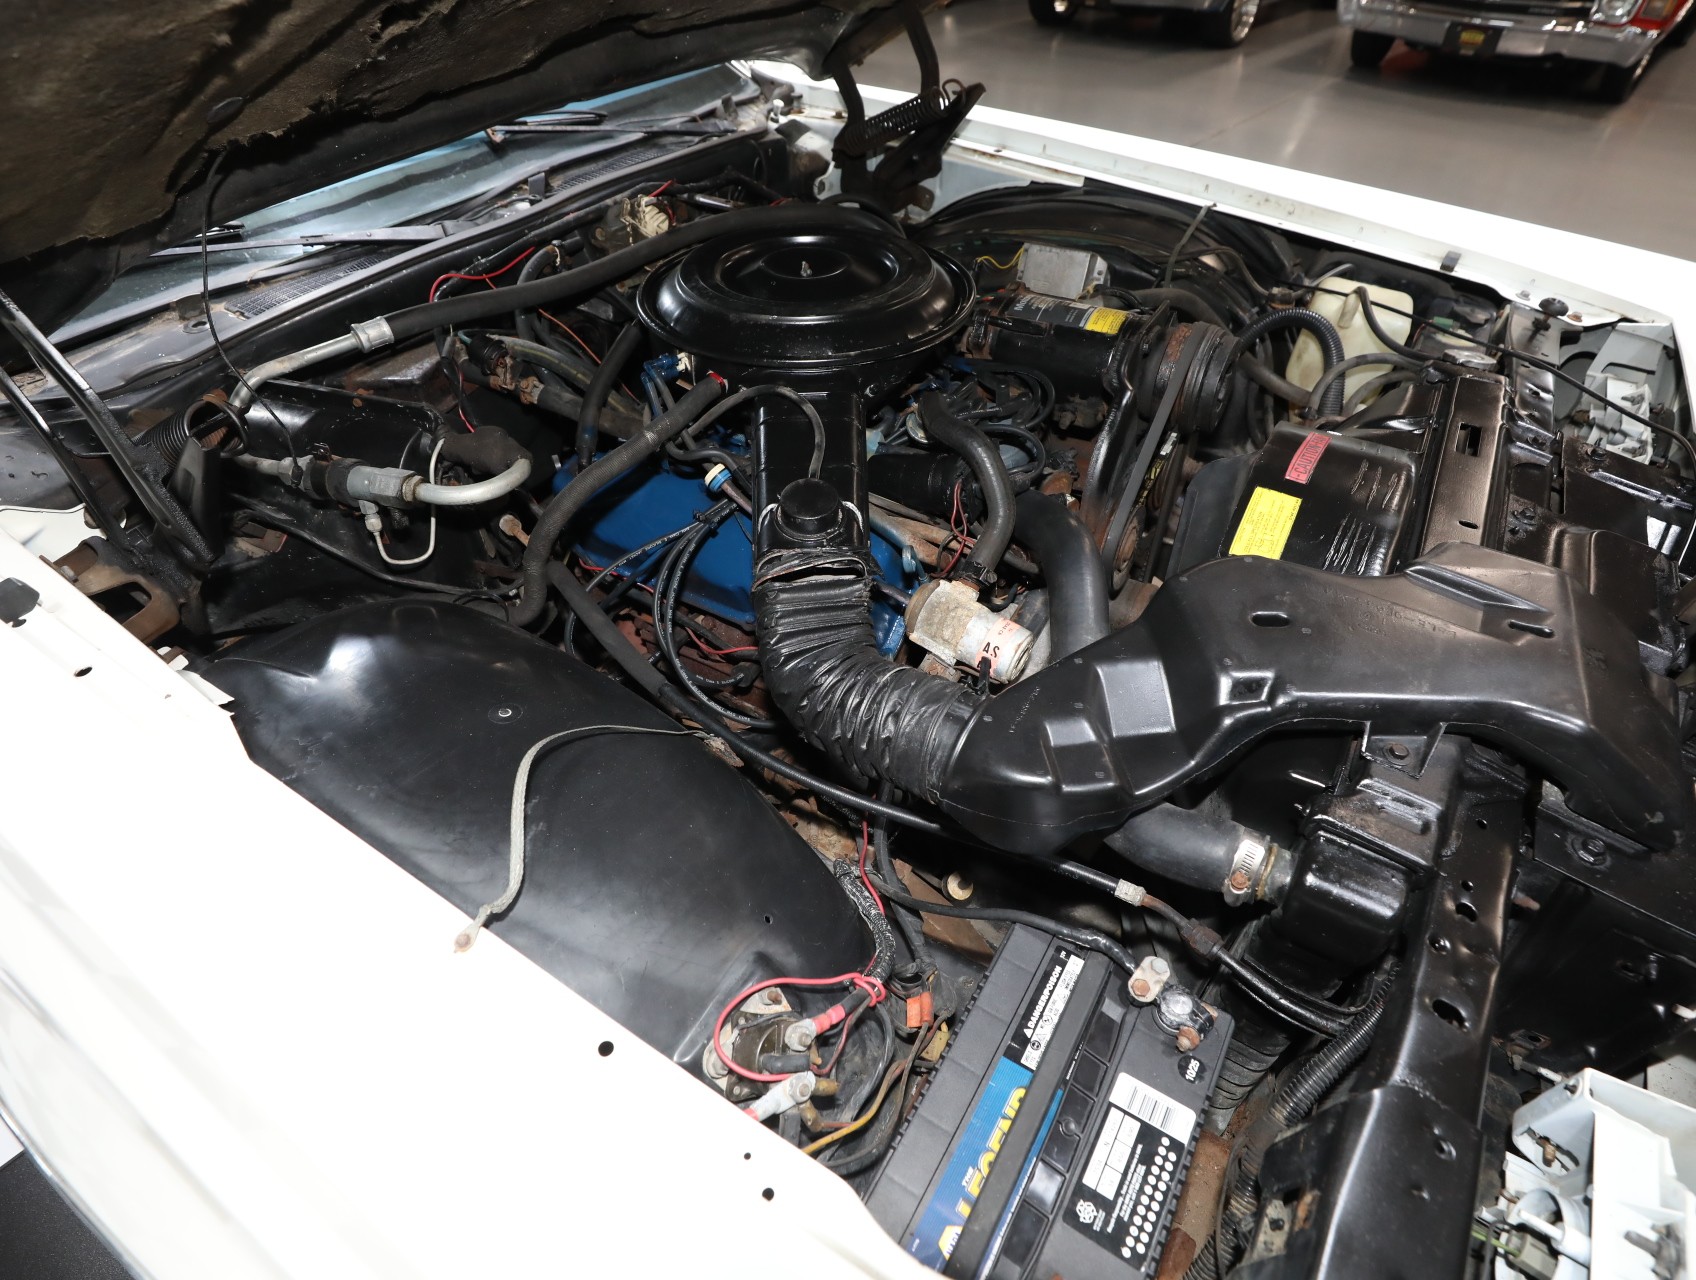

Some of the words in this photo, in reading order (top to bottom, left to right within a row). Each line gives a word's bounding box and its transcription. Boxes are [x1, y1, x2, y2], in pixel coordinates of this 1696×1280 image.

[1028, 965, 1062, 1029] DANGER/POISON
[1186, 1058, 1200, 1082] 10/25
[962, 1166, 974, 1186] THE
